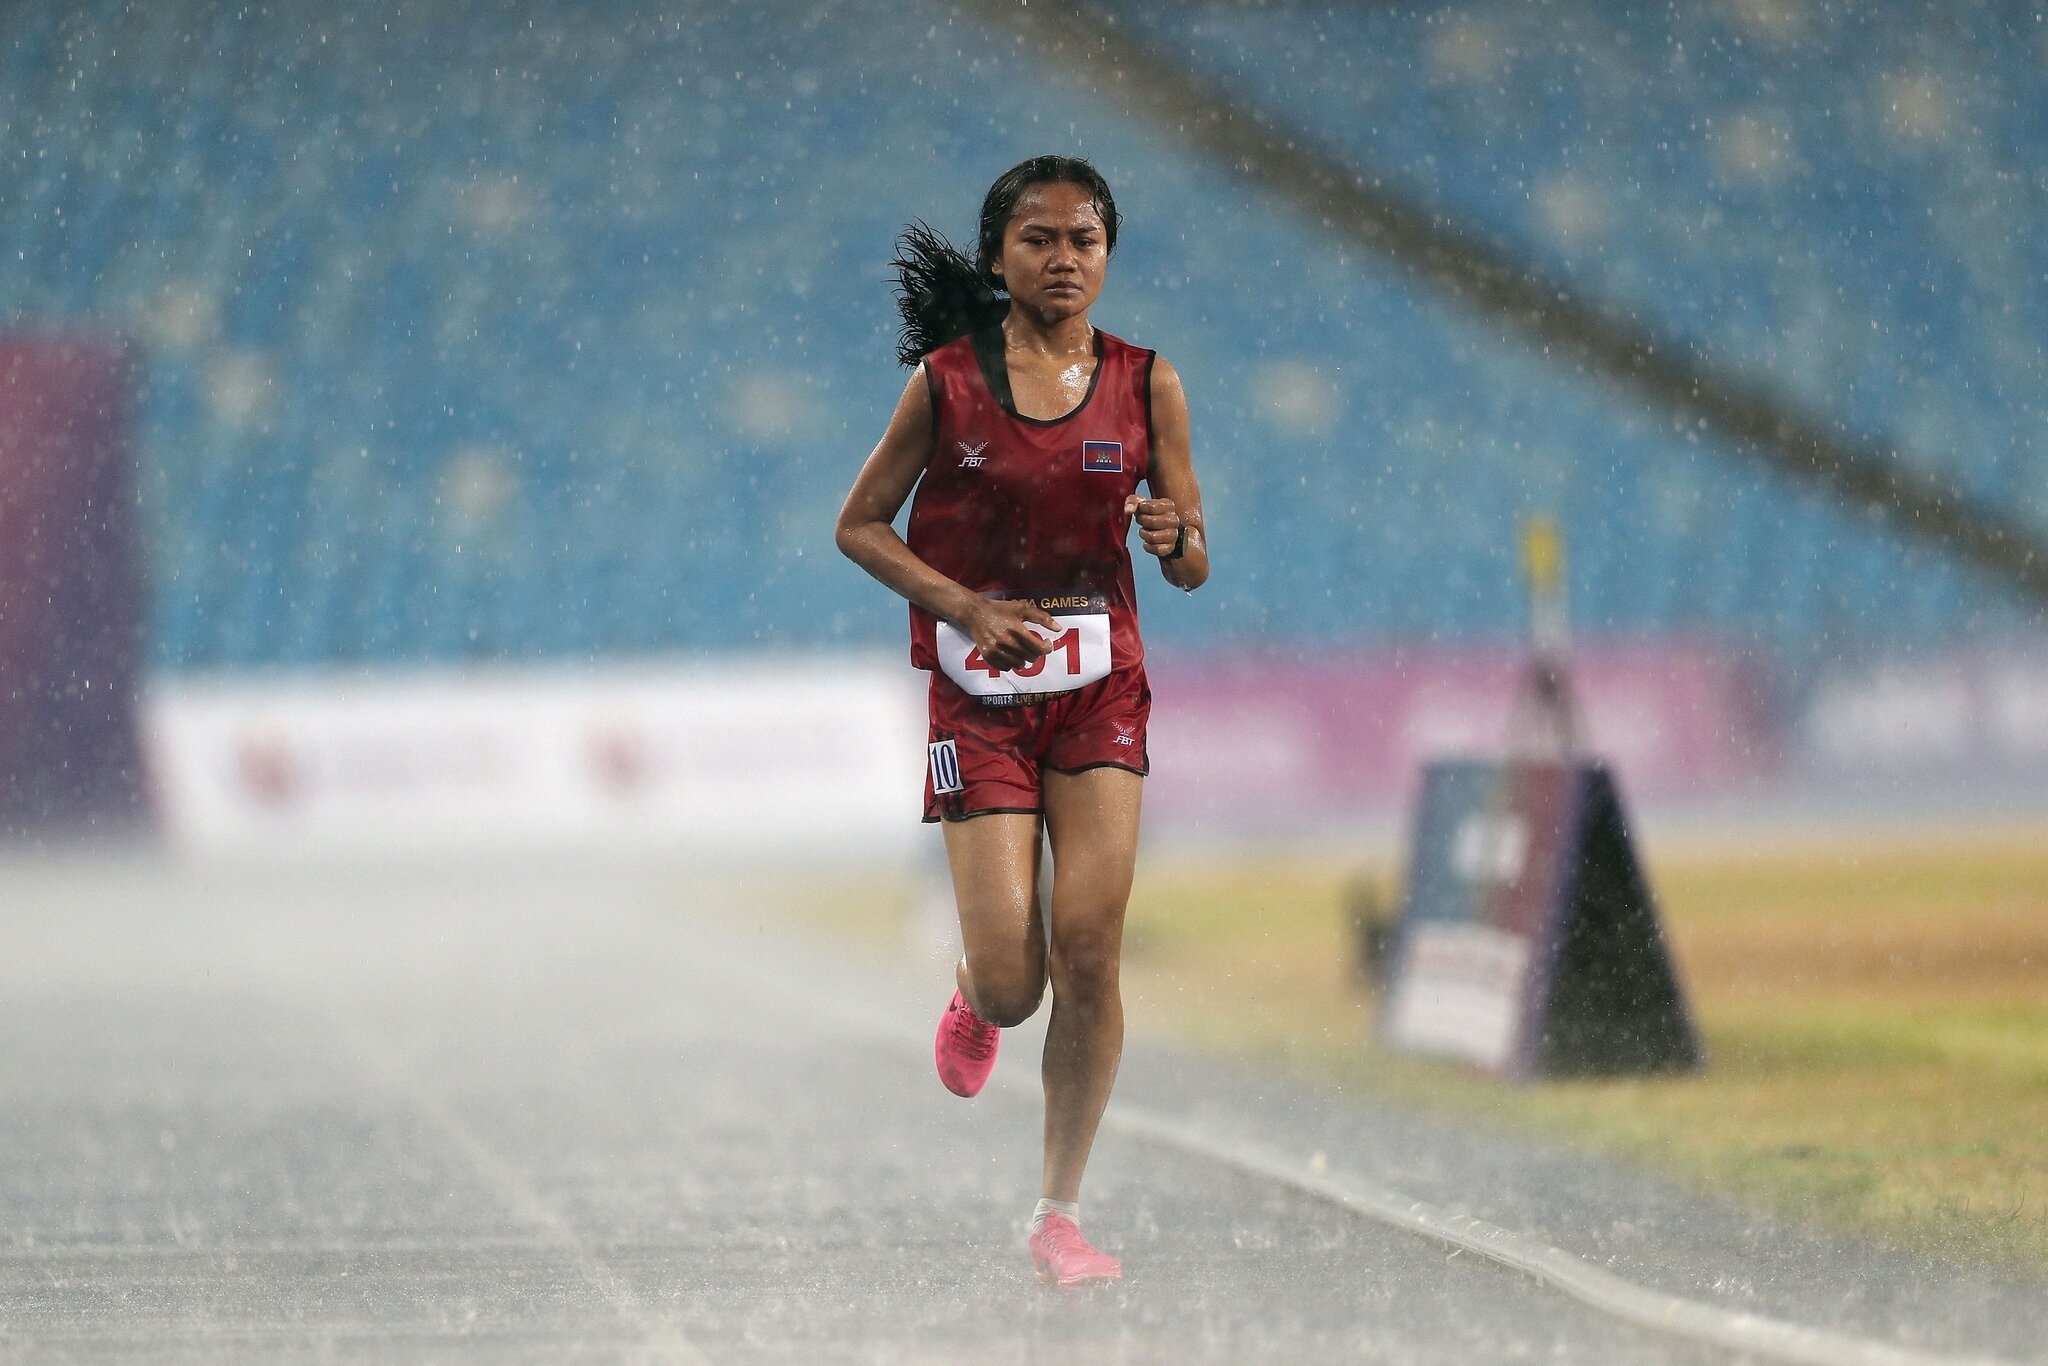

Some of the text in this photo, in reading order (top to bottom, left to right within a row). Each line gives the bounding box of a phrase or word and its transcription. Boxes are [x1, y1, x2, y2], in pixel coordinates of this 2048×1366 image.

[958, 456, 987, 468] FBT
[1041, 596, 1089, 609] GAMES
[1016, 693, 1033, 704] LIVE
[1112, 735, 1136, 746] FBT
[931, 744, 958, 791] 10
